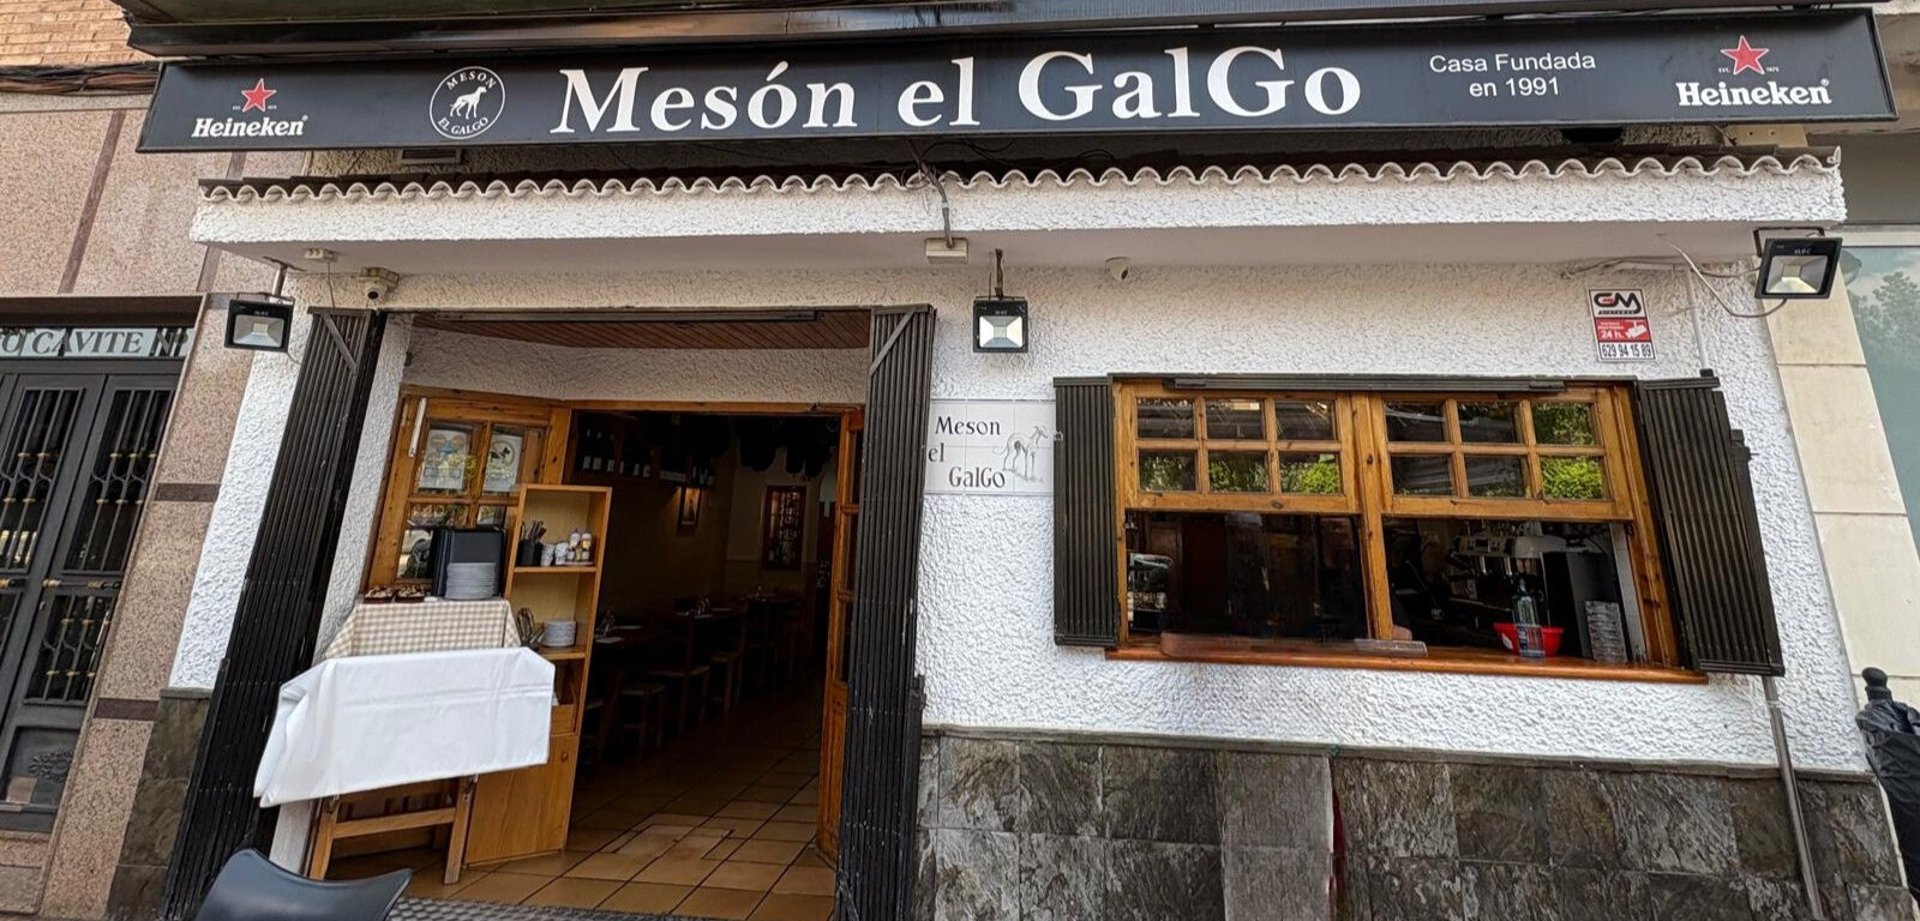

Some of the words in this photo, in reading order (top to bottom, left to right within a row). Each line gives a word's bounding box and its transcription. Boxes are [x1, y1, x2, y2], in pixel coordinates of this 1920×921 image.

[1429, 55, 1488, 73] Casa
[1495, 52, 1597, 72] Fundada
[446, 70, 497, 90] MESON
[549, 61, 858, 133] Mesón
[897, 56, 981, 127] el
[1018, 46, 1361, 121] GalGo
[1469, 81, 1498, 97] en
[1505, 77, 1560, 97] 1991
[1675, 80, 1833, 106] Heineken
[191, 116, 305, 138] Heineken
[438, 117, 450, 131] EL
[451, 117, 488, 134] GALGO
[0, 331, 24, 354] O
[32, 331, 144, 355] CAVITE
[1600, 329, 1613, 339] 24
[1602, 344, 1617, 357] 629
[1630, 344, 1640, 357] 15
[935, 415, 1001, 436] Meson
[928, 442, 945, 463] el
[949, 466, 1006, 489] GalGo
